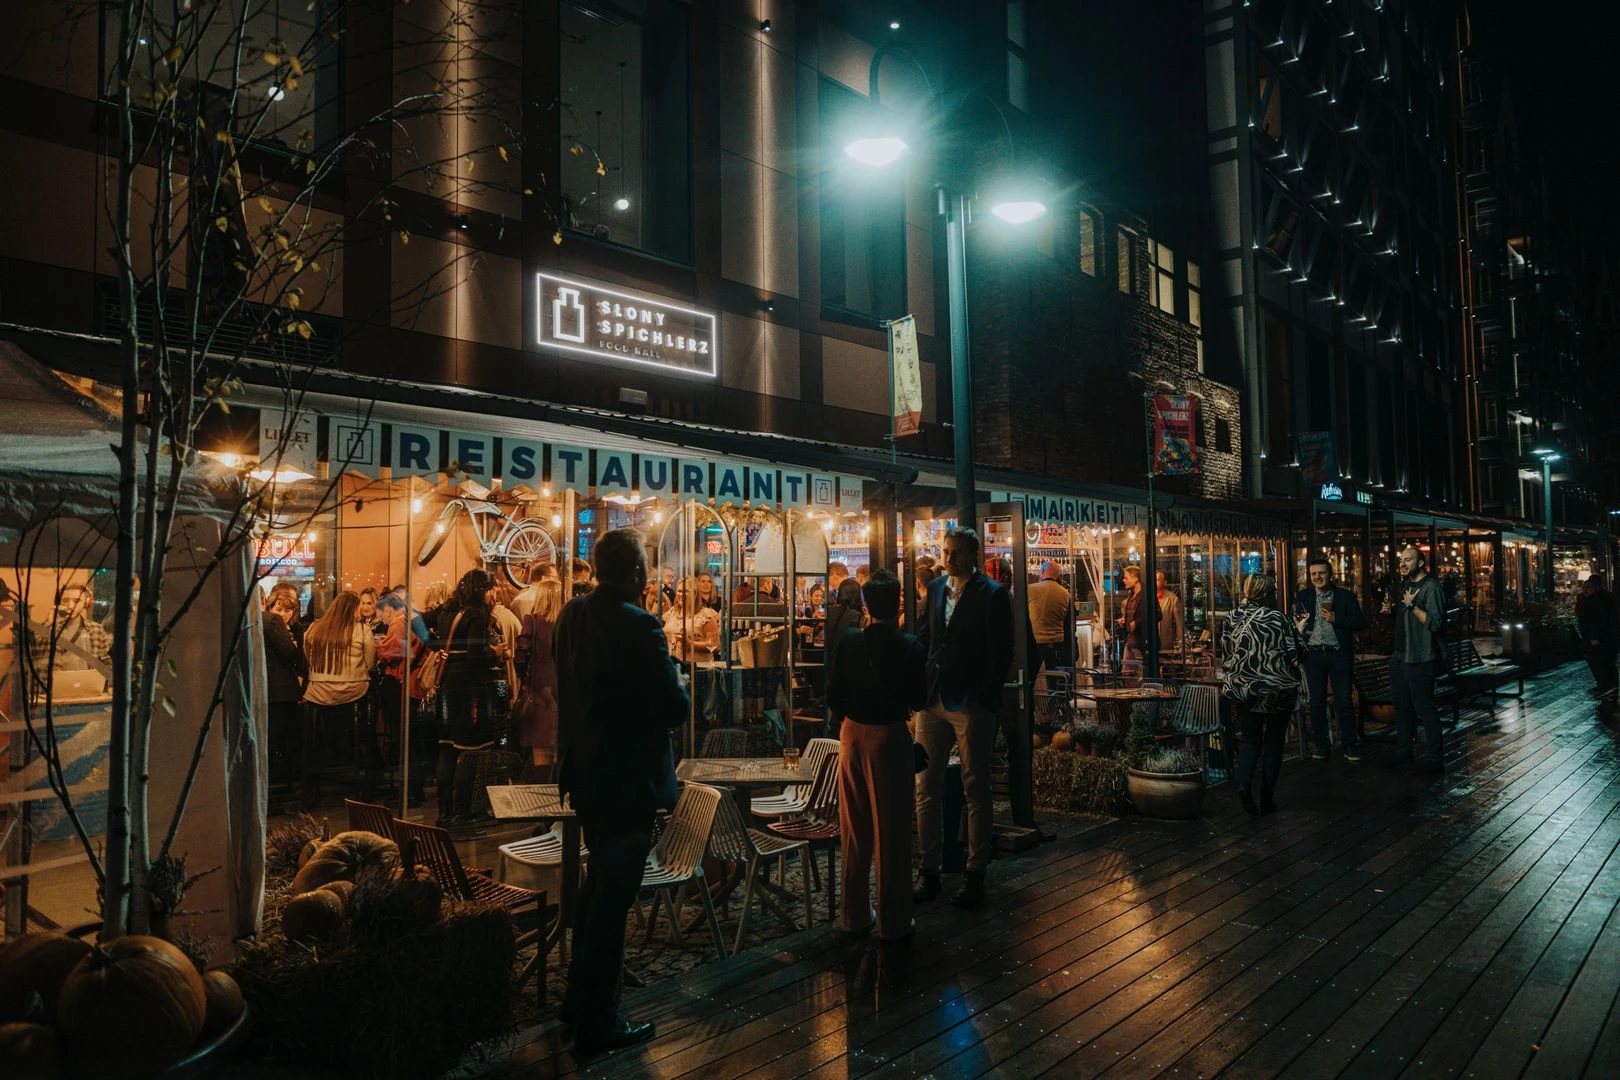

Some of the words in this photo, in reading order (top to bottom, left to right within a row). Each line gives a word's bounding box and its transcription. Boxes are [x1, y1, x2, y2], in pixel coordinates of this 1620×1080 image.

[597, 320, 708, 354] SPICHLERZ
[400, 432, 803, 502] RESTAURANT
[1030, 499, 1120, 524] MARKET
[255, 539, 315, 558] BULL
